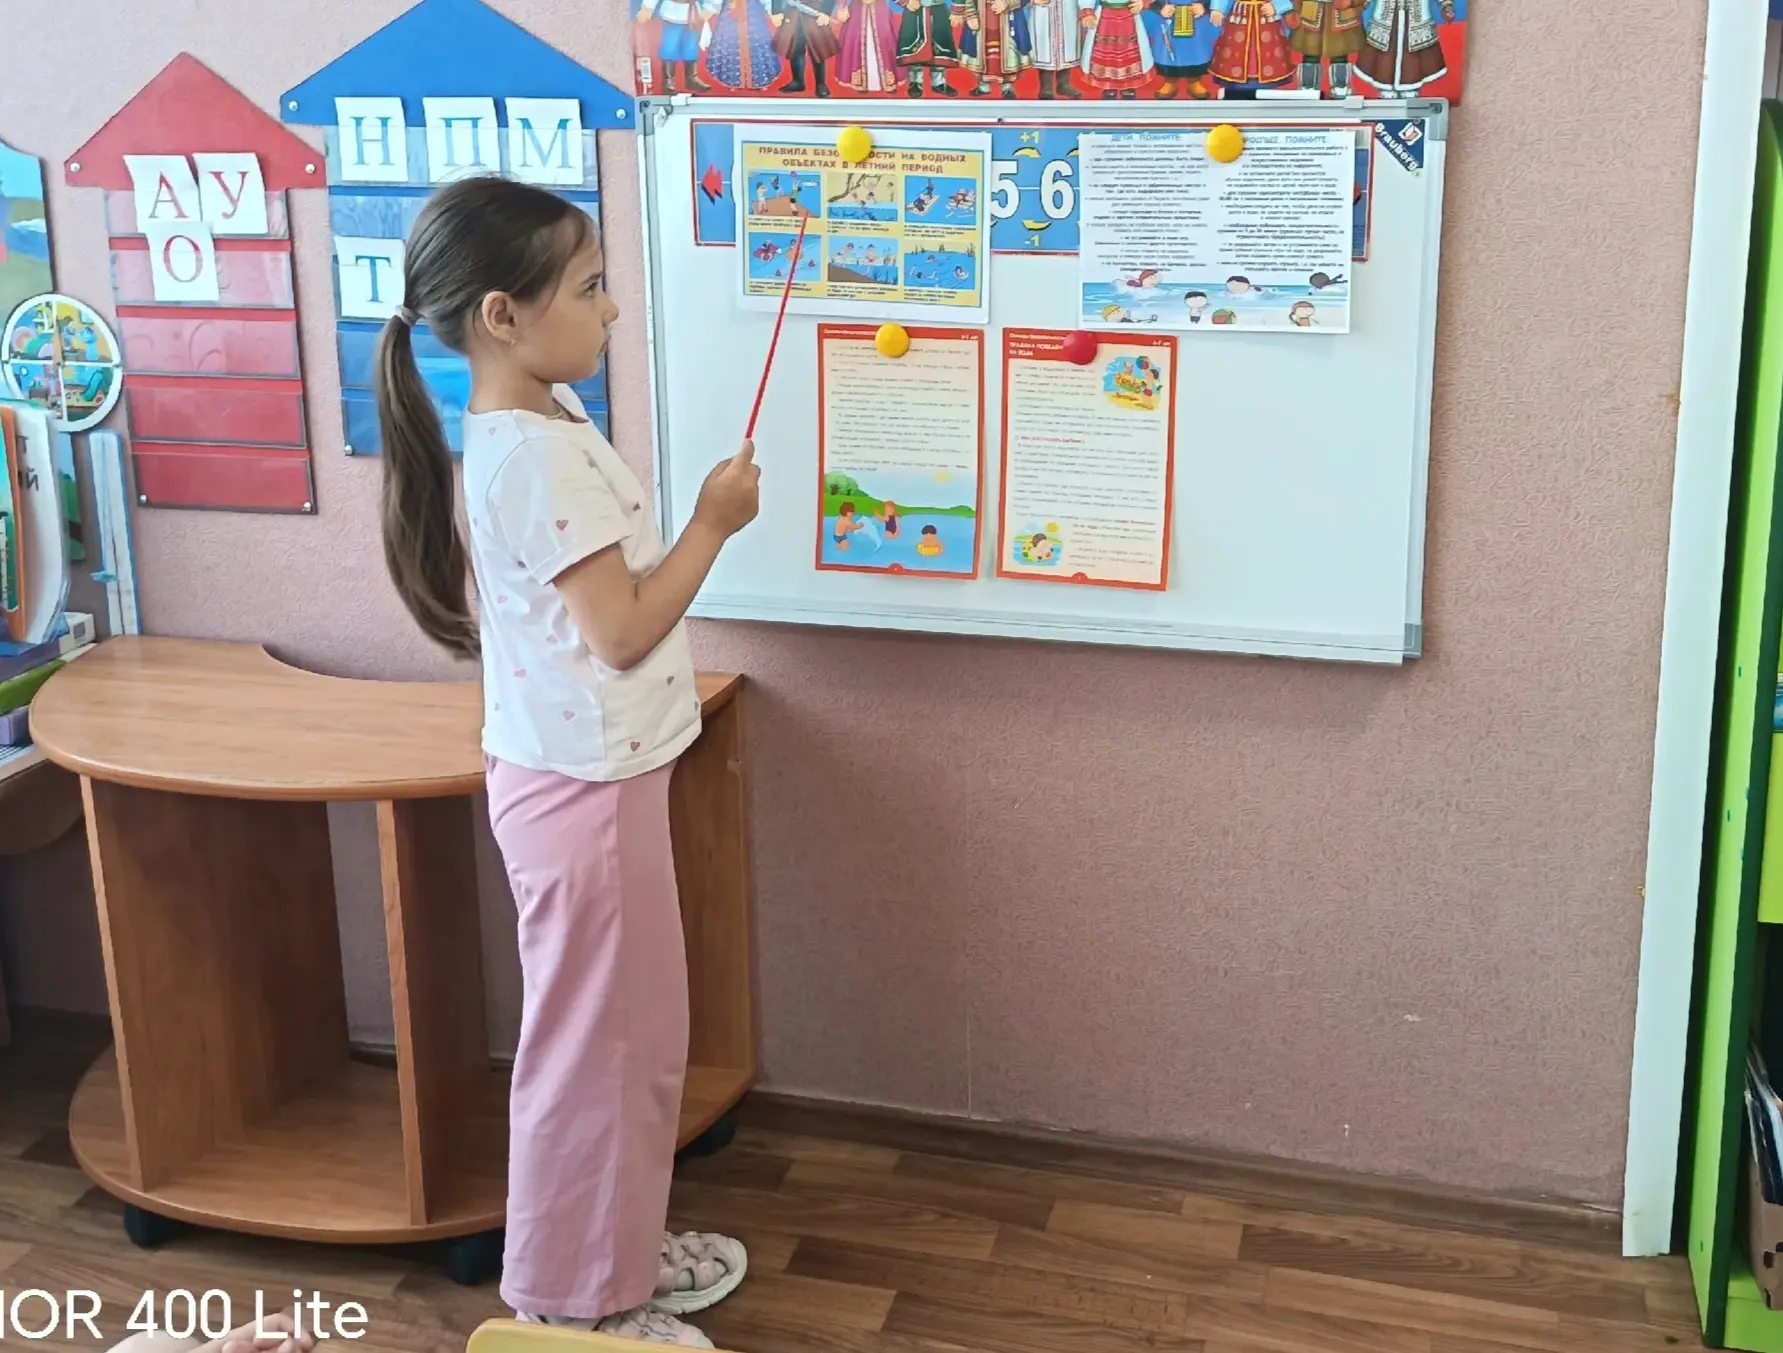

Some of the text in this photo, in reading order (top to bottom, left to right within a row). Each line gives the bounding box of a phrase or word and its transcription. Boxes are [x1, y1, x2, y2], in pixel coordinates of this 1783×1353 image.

[350, 116, 574, 170] Н П М
[759, 146, 808, 156] ПРАВИЛА
[901, 153, 915, 161] НА
[1020, 130, 1040, 144] +1
[782, 158, 837, 168] ОБЪЕКТАХ
[901, 163, 944, 174] ПЕРИОД
[991, 158, 1021, 220] 5
[1040, 158, 1076, 220] 6
[149, 170, 250, 220] А У
[163, 234, 204, 284] О
[1024, 234, 1041, 248] -1
[355, 254, 391, 304] Т
